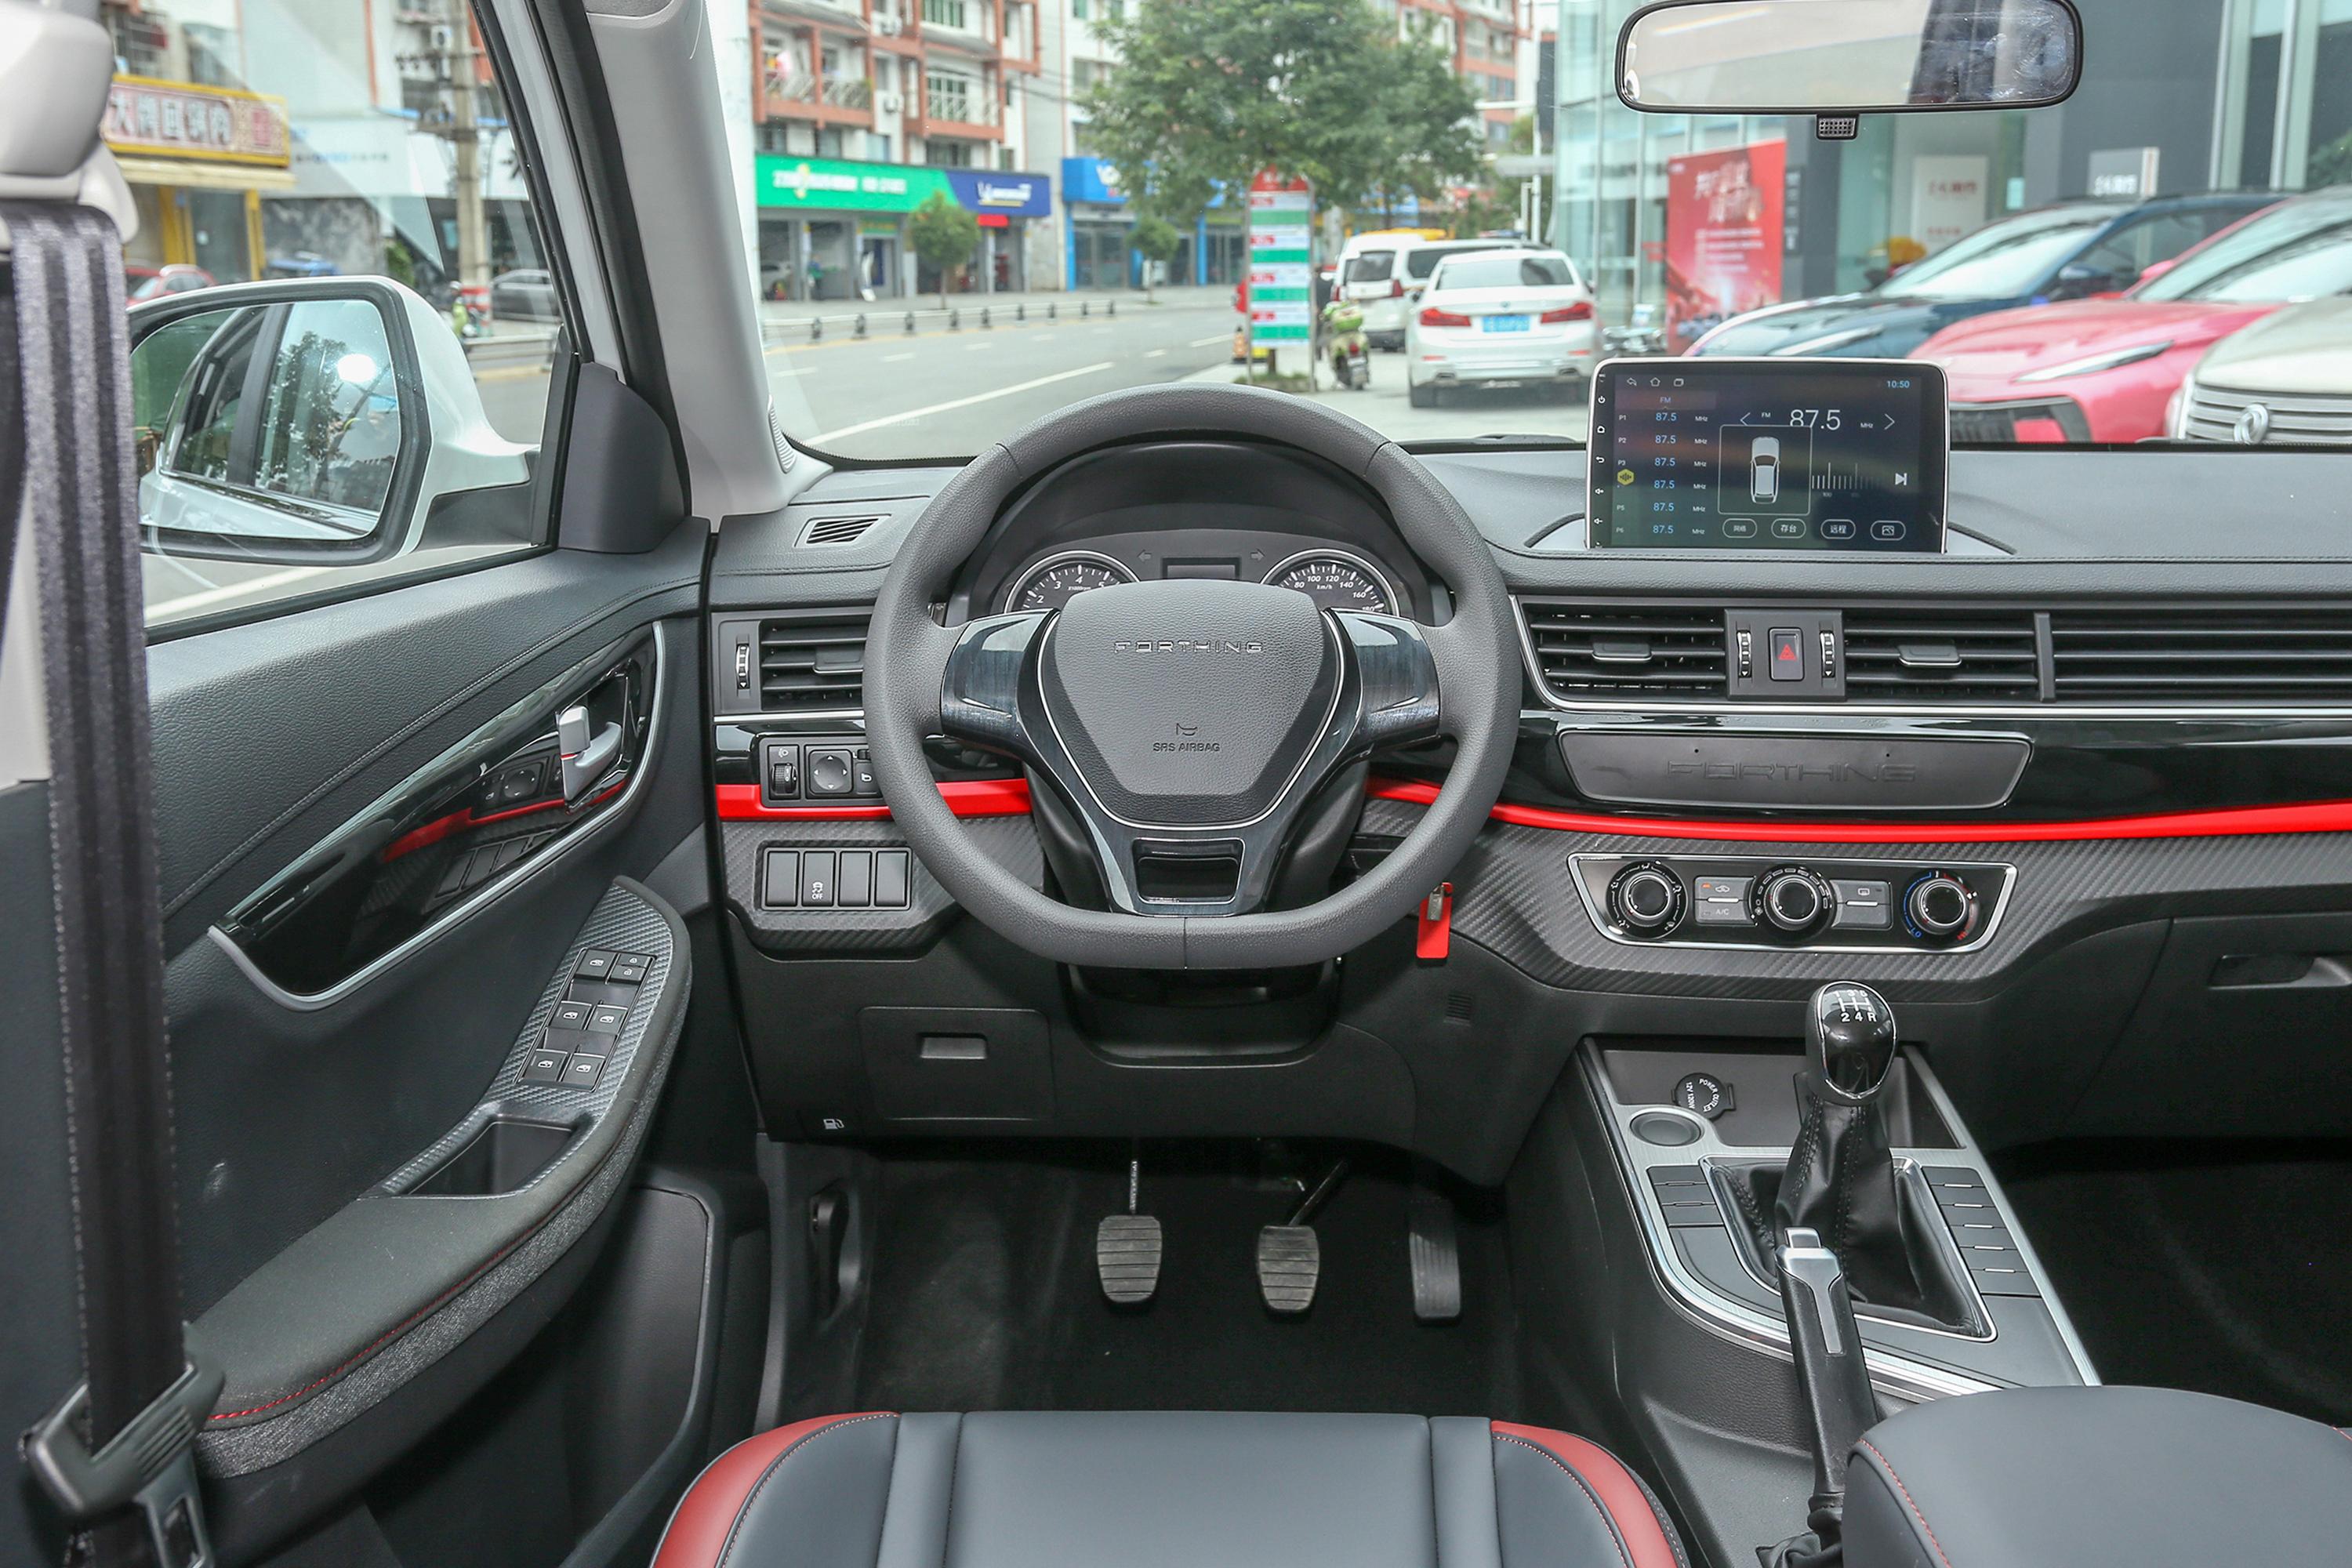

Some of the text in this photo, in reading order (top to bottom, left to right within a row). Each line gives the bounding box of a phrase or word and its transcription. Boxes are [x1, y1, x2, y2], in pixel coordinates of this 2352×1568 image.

[1656, 412, 1677, 421] 87.5
[1790, 409, 1841, 430] 87.5
[1655, 435, 1676, 444] 87.5
[1654, 458, 1675, 466] 87.5
[1653, 480, 1675, 488] 87.5
[1653, 503, 1675, 511] 87.5
[1653, 525, 1674, 534] 87.5
[1780, 524, 1798, 533] 存台
[1830, 524, 1847, 534] 远程
[1036, 595, 1044, 604] 2
[1113, 640, 1263, 654] FORTHING
[1152, 742, 1221, 752] SRS AIRBAG
[1668, 760, 1916, 782] FORTHING
[1841, 1011, 1877, 1022] 2 4 R
[1699, 1078, 1720, 1112] POWER OUTLET
